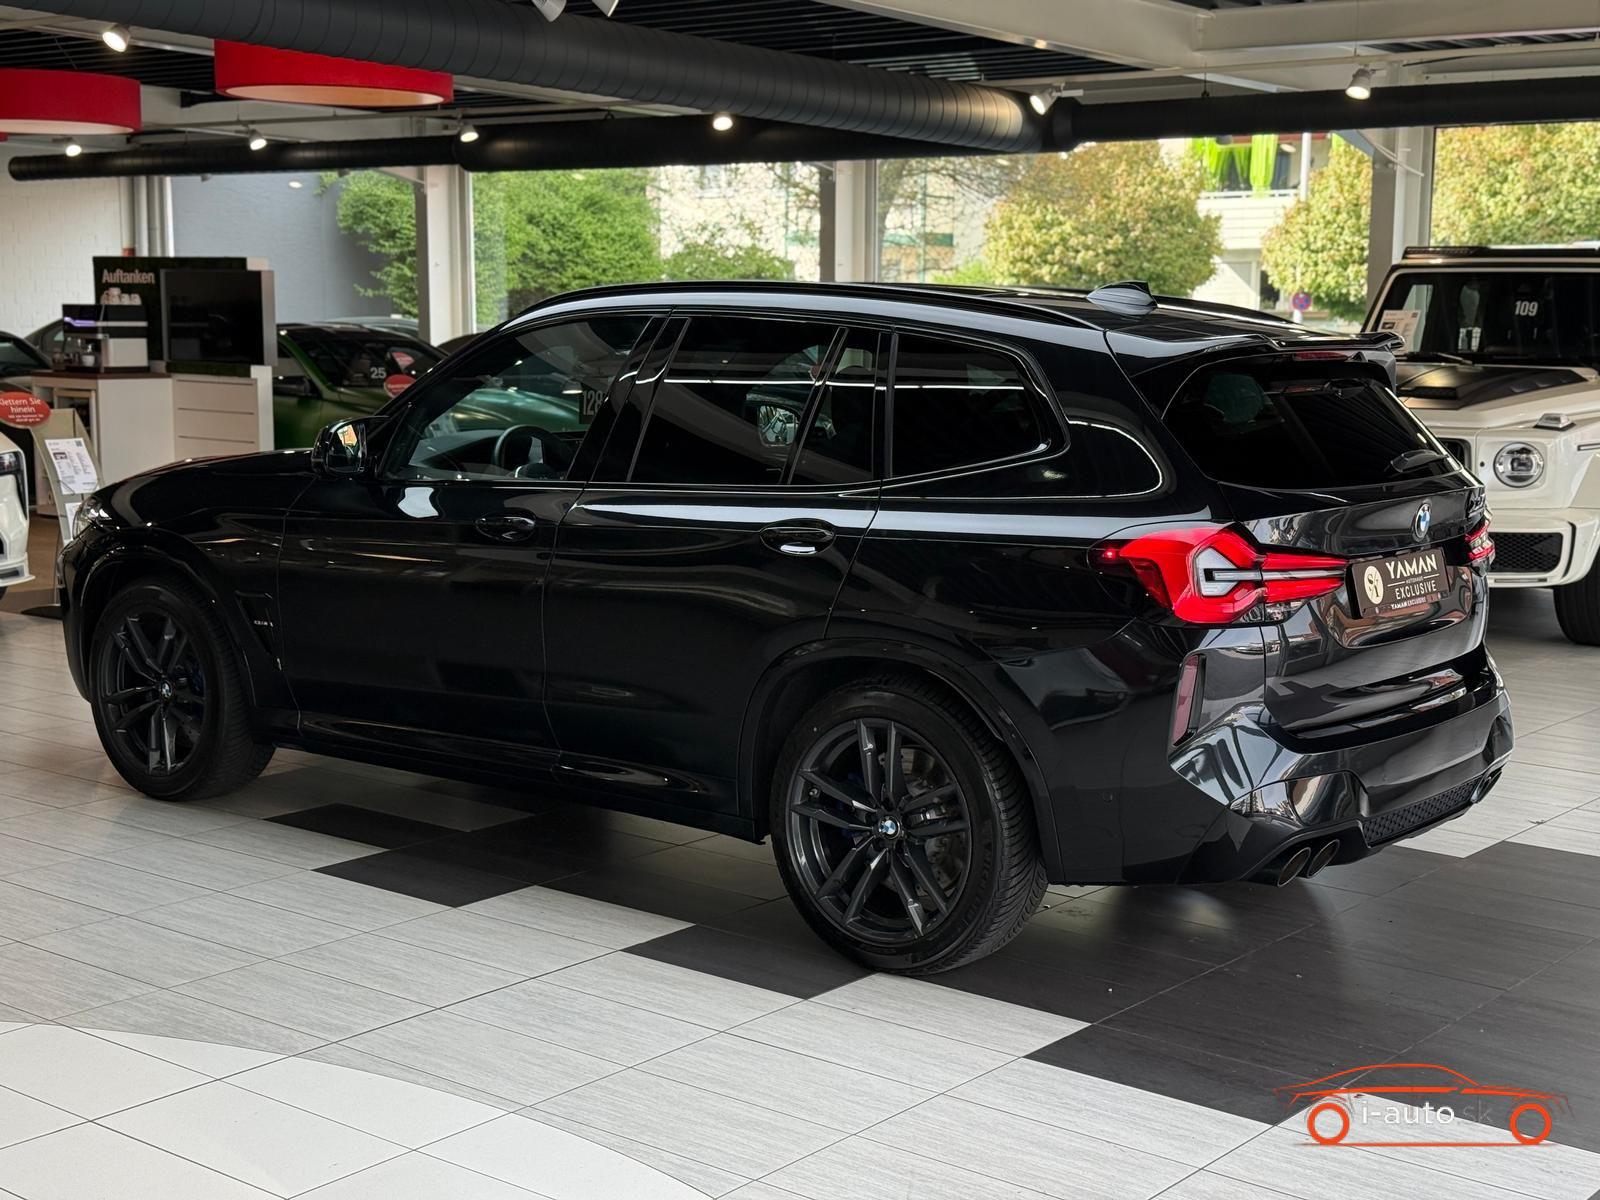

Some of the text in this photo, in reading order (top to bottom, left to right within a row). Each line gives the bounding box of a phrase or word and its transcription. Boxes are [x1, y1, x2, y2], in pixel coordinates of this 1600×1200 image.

[102, 268, 155, 284] Auftanken
[1515, 300, 1538, 316] 109
[370, 366, 387, 379] 25
[29, 397, 41, 405] Sie
[1385, 554, 1437, 579] YAMAN
[1395, 580, 1437, 600] EXCLUSIVE
